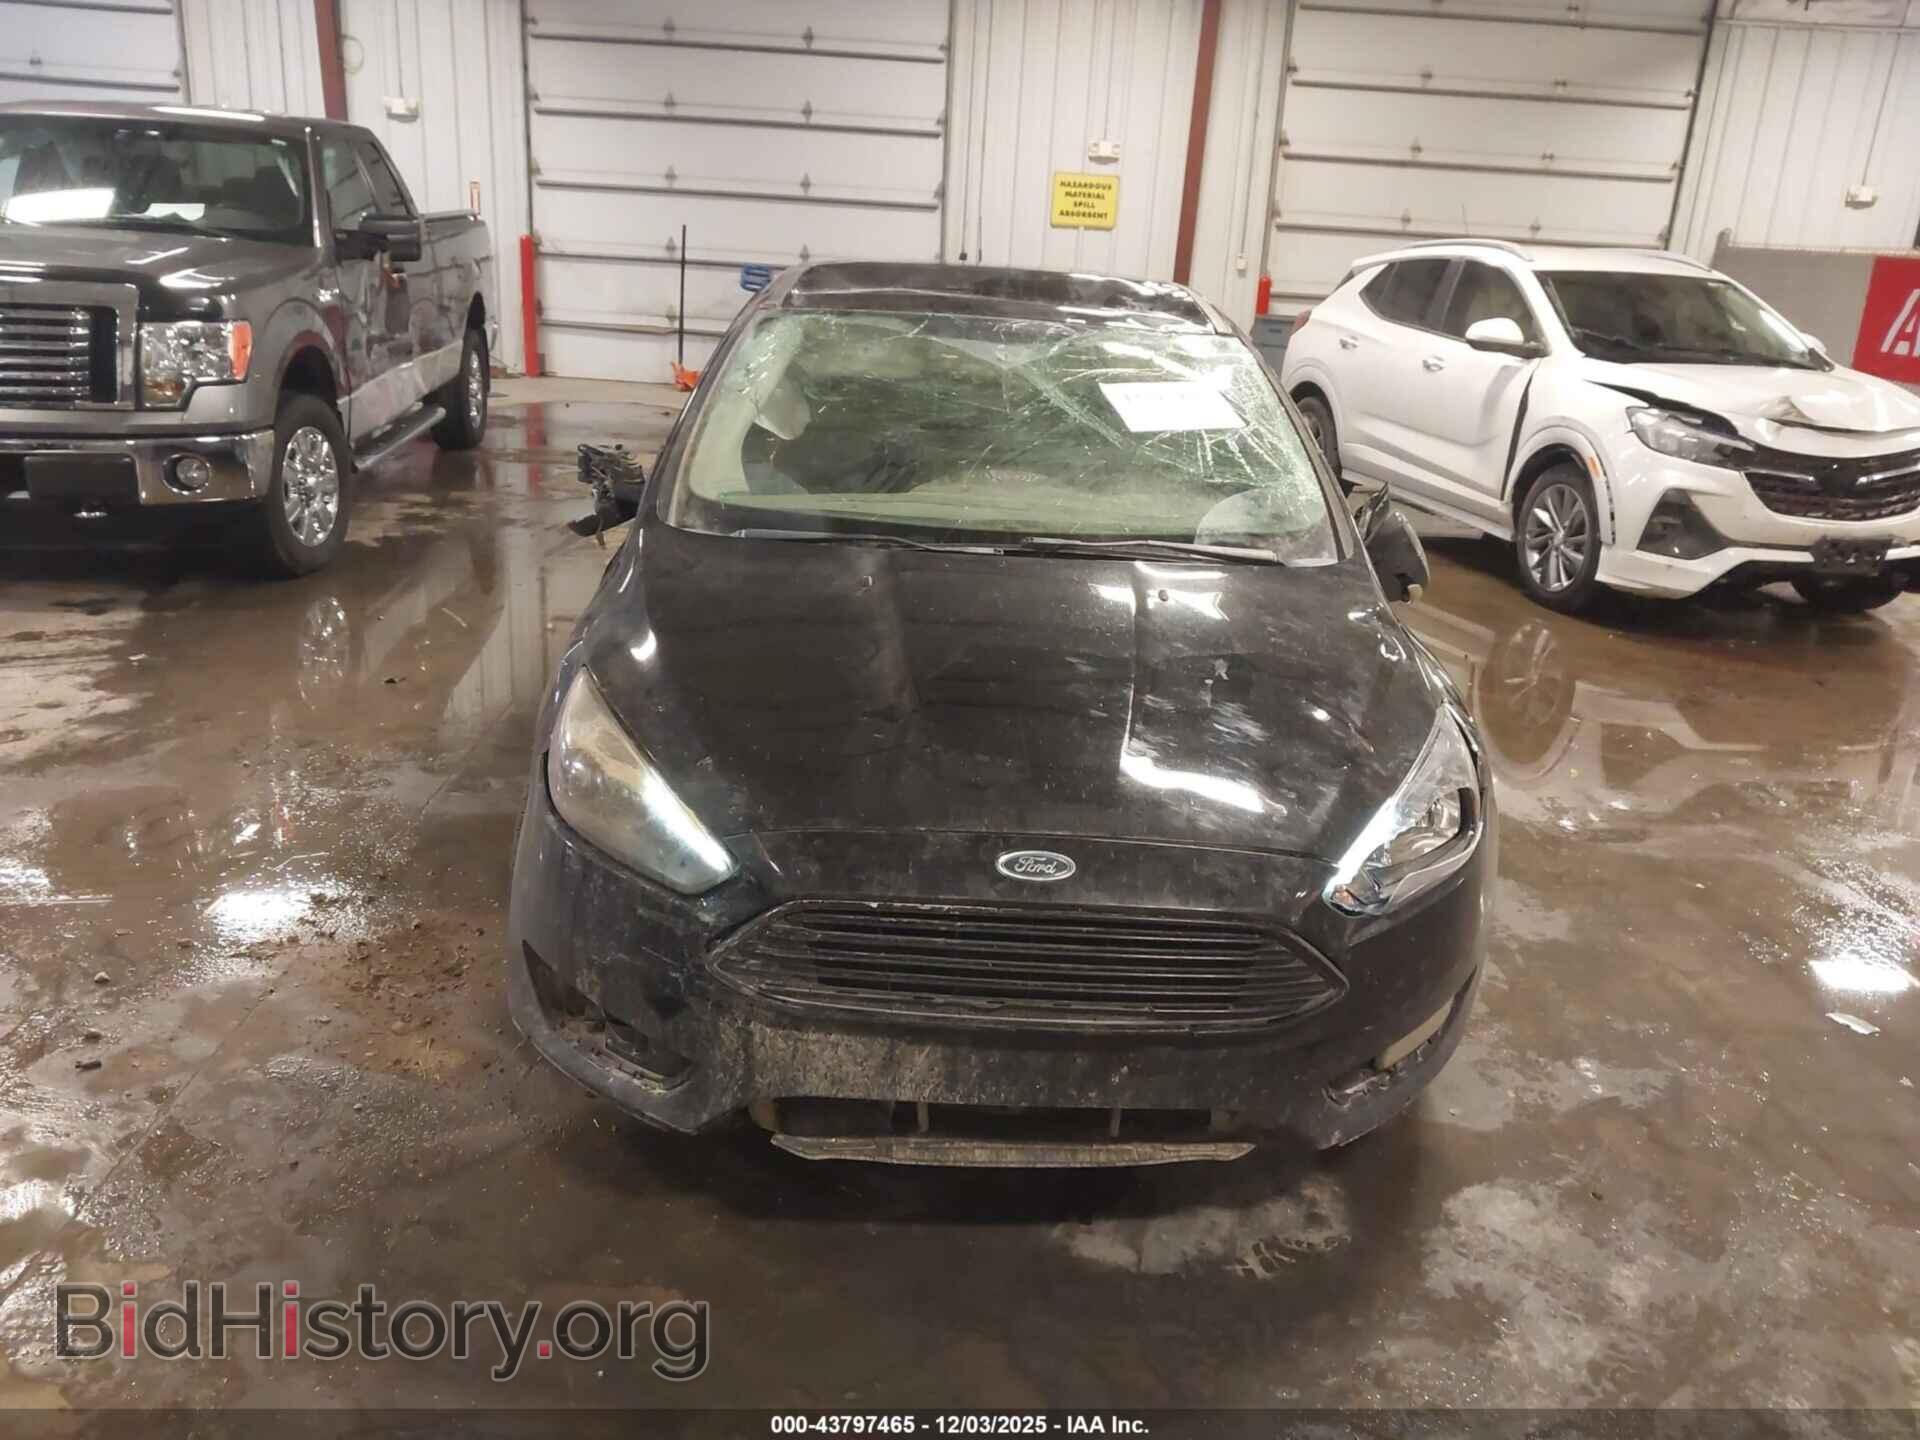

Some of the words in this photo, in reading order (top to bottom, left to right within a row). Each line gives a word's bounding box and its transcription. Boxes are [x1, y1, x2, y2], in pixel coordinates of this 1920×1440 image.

[1060, 181, 1112, 190] HAZARDOUS
[1065, 191, 1105, 199] MATERIAL
[1059, 210, 1108, 219] ABSORBENT
[1014, 856, 1058, 874] Ford
